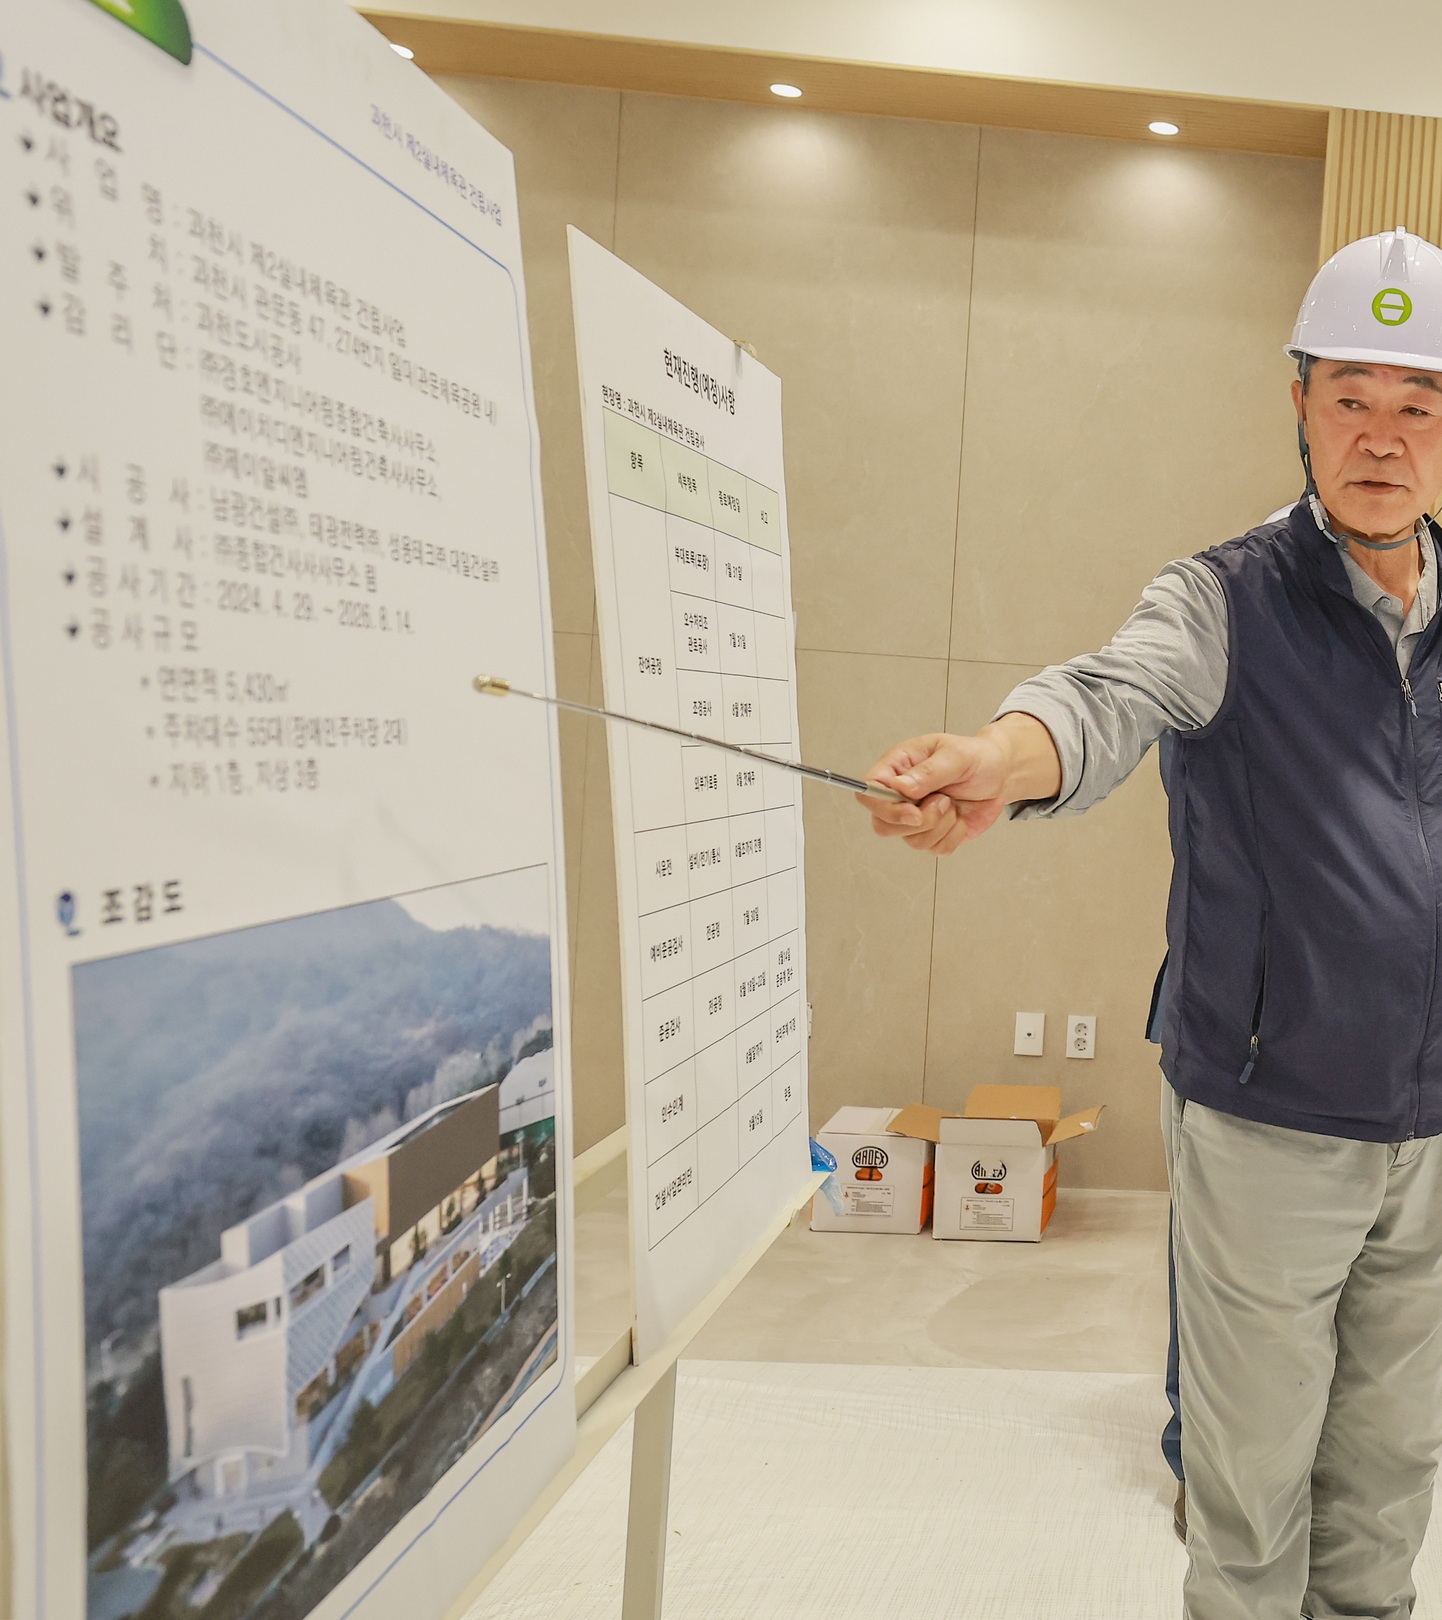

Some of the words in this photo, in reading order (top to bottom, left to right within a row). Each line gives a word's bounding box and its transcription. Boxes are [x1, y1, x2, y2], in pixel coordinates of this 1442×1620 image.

[20, 66, 122, 150] 사업개요
[188, 207, 243, 265] 과천시
[192, 255, 246, 308] 과천시
[254, 283, 304, 336] 관문동
[196, 301, 302, 375] 과천도시공사
[663, 347, 736, 416] 현재진행(예정)사항
[602, 383, 622, 410] 현장명
[627, 398, 646, 423] 과천시
[647, 407, 684, 441] 제2실내체육관
[684, 427, 706, 452] 건립공사
[630, 450, 644, 473] 항목
[162, 711, 242, 751] 주차대수
[255, 760, 289, 794] 지상
[655, 858, 673, 878] 시운전
[650, 934, 684, 962] 예비준공검사
[659, 1015, 681, 1043] 준공검사
[661, 1093, 684, 1124] 인수인계
[855, 1149, 885, 1166] ARDEX
[654, 1166, 693, 1211] 건설사업관리단
